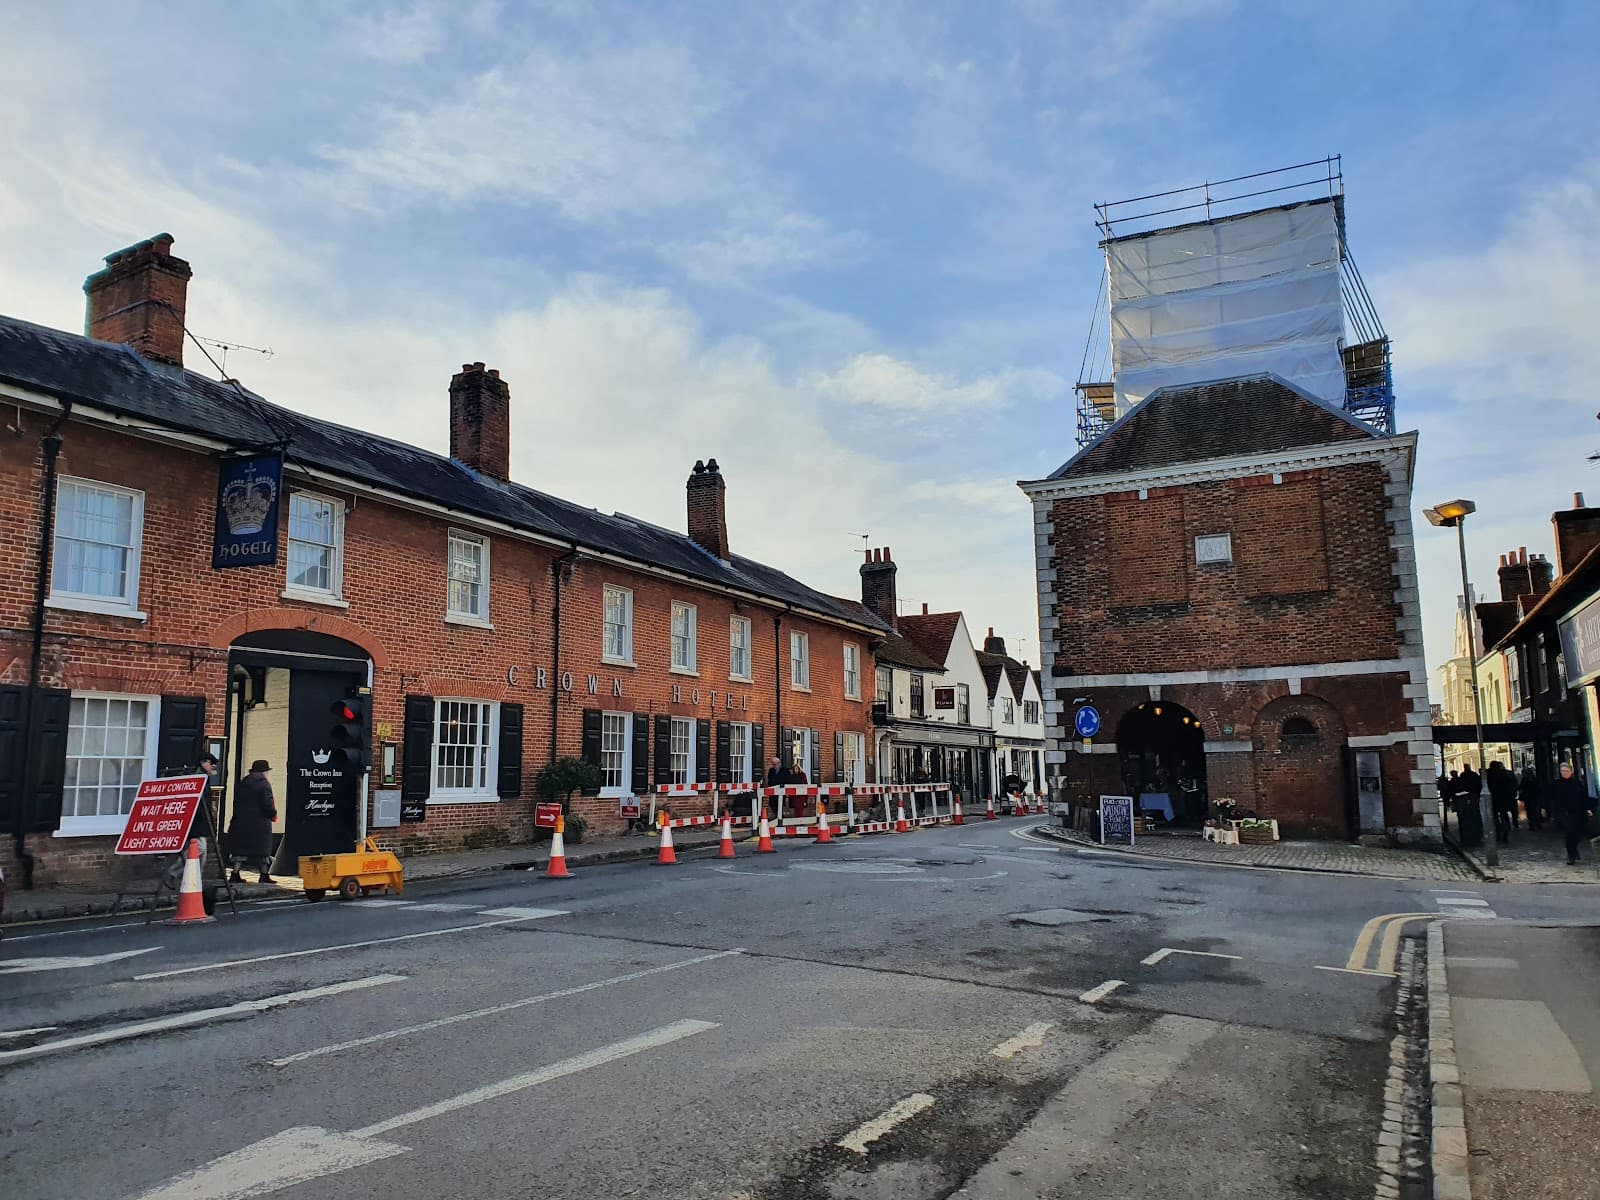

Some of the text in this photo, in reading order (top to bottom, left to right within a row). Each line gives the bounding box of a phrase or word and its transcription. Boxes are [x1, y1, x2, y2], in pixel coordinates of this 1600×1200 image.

[508, 664, 749, 711] CROWN HOTEL
[300, 768, 343, 777] The Crown Inn
[143, 782, 198, 794] 3-WAY CONTROL
[309, 780, 333, 790] Reception
[140, 801, 188, 816] WAIT HERE
[132, 820, 184, 833] UNTIL GREEN
[123, 836, 180, 849] LIGHT SHOWS
